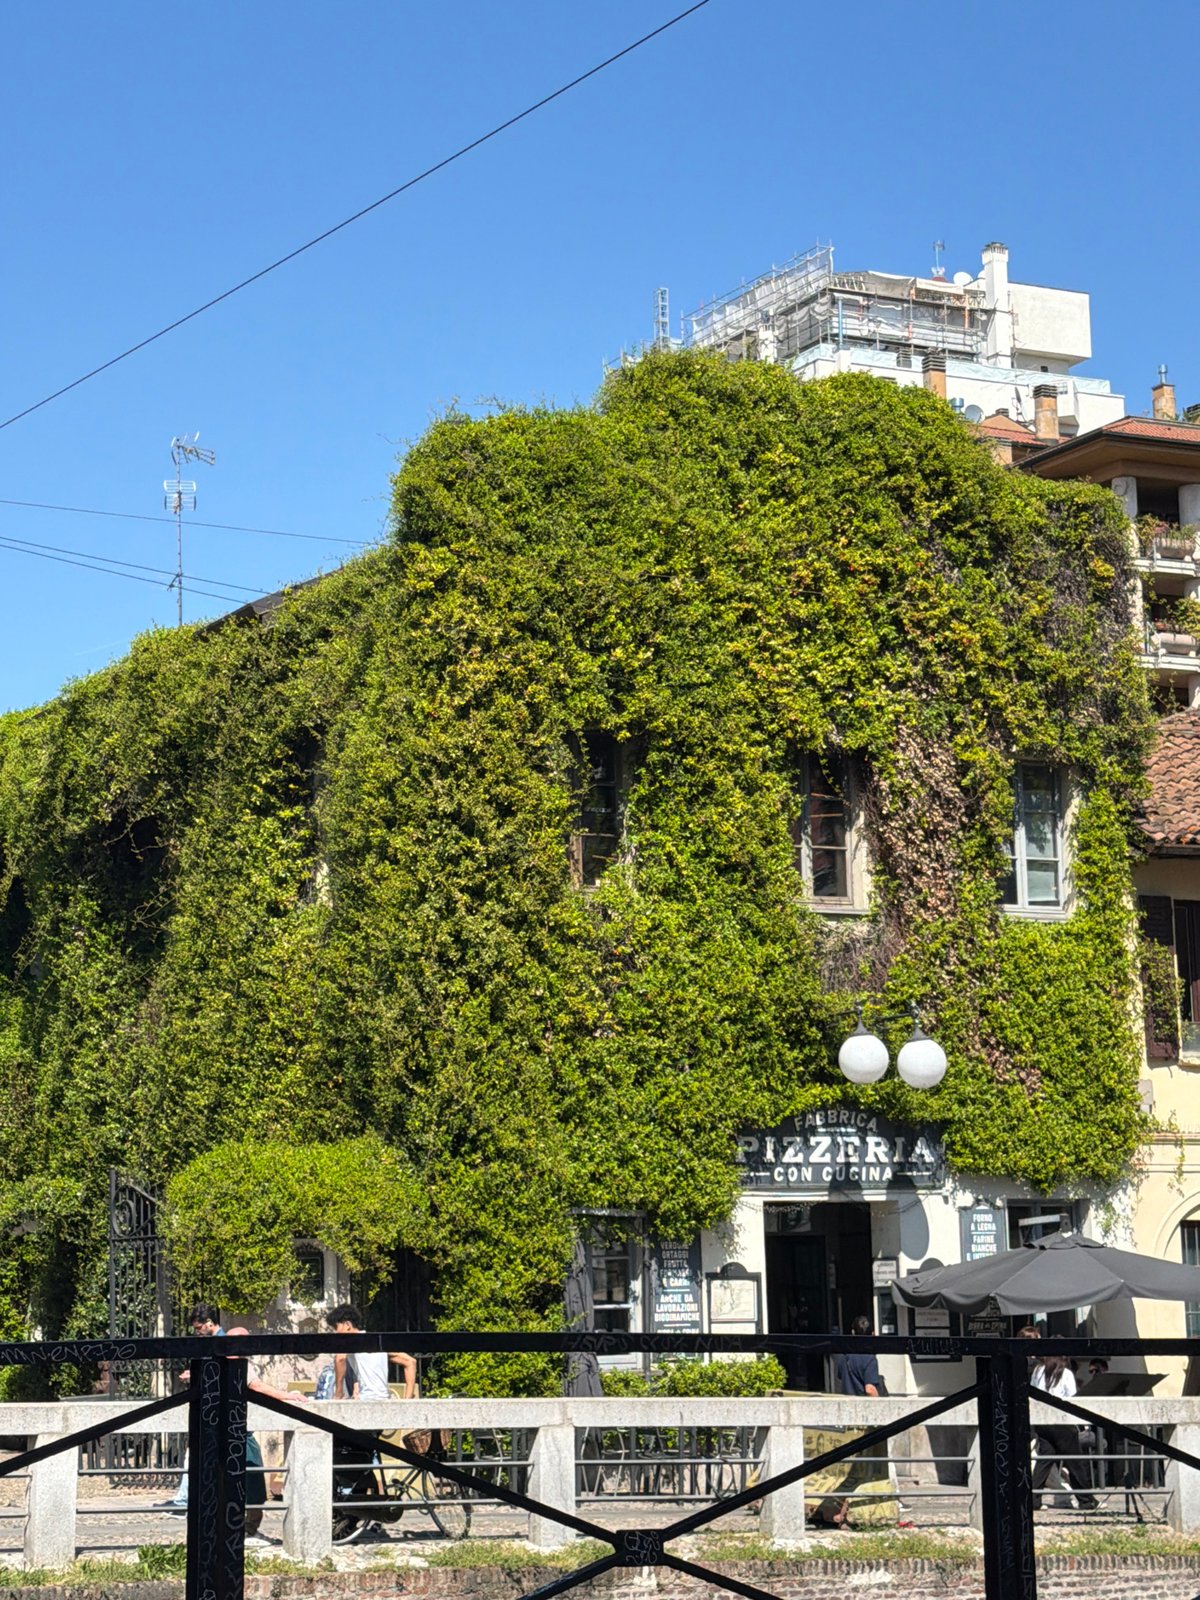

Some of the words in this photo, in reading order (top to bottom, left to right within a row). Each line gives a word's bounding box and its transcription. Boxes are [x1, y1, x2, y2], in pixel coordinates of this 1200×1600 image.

[794, 1110, 878, 1132] FABBRICA
[736, 1136, 935, 1163] PIZZERIA
[774, 1167, 812, 1182] CON
[822, 1166, 893, 1182] CUCINA
